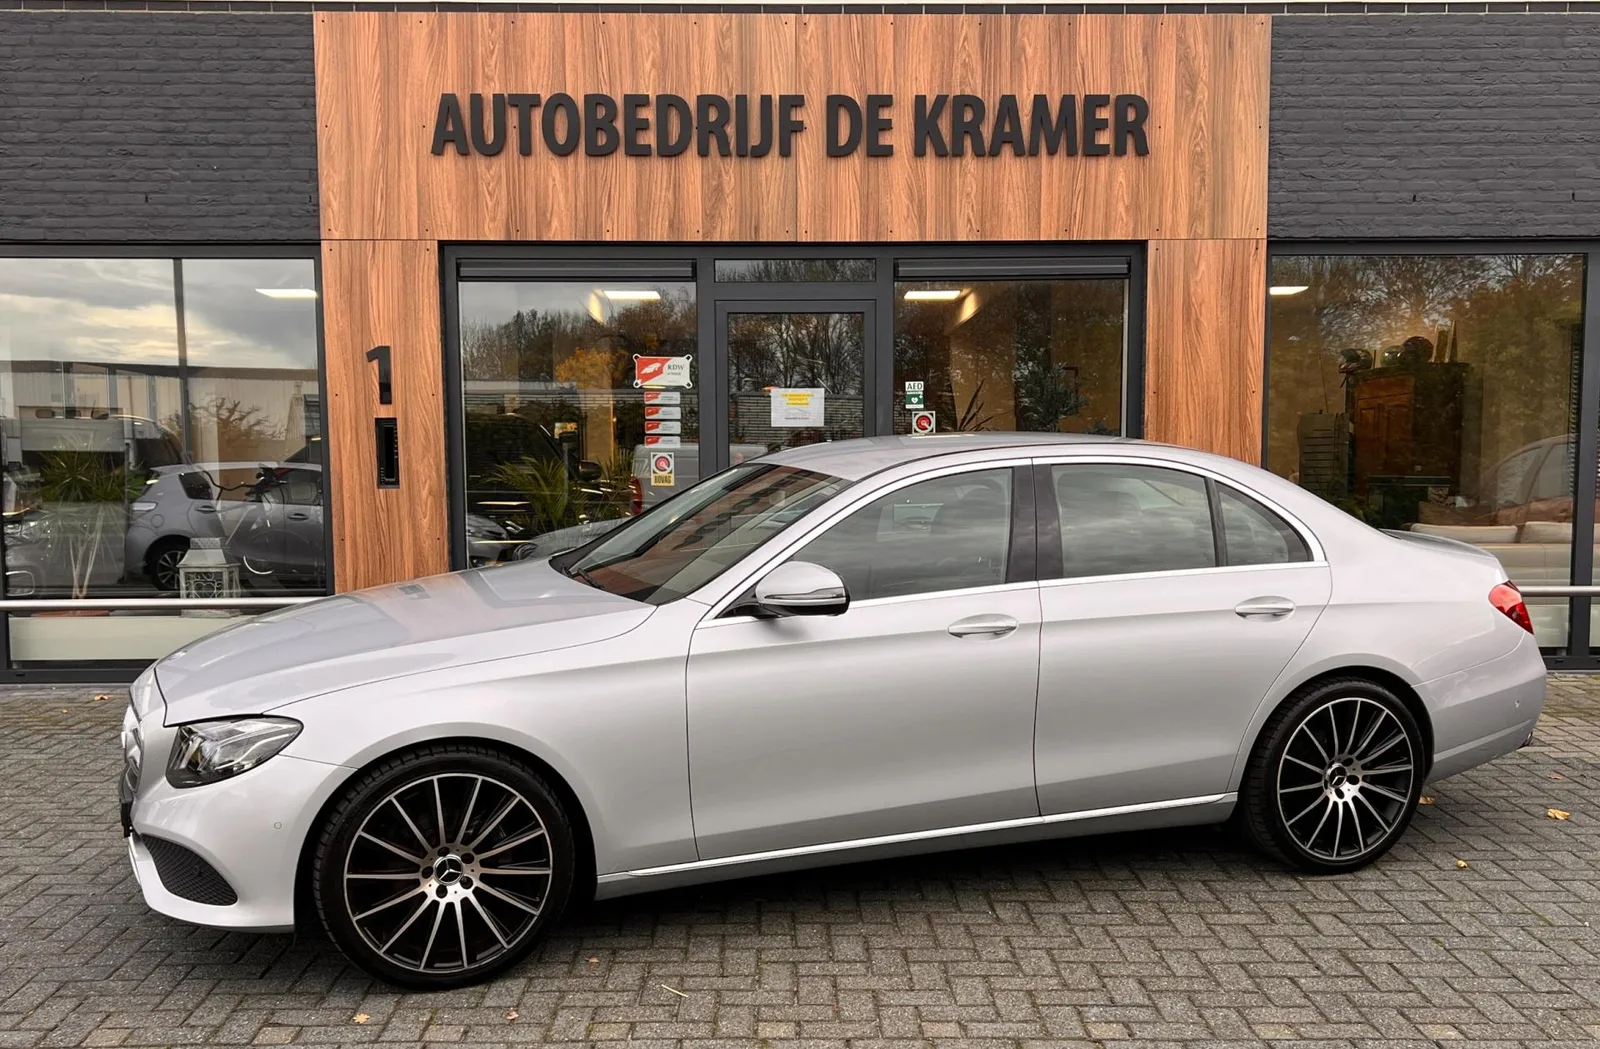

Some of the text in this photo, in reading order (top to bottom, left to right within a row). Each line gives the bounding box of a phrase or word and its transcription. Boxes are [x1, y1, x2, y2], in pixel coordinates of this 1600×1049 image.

[431, 93, 1150, 158] AUTOBEDRIJF DE KRAMER
[366, 345, 392, 404] 1
[907, 382, 922, 390] AED
